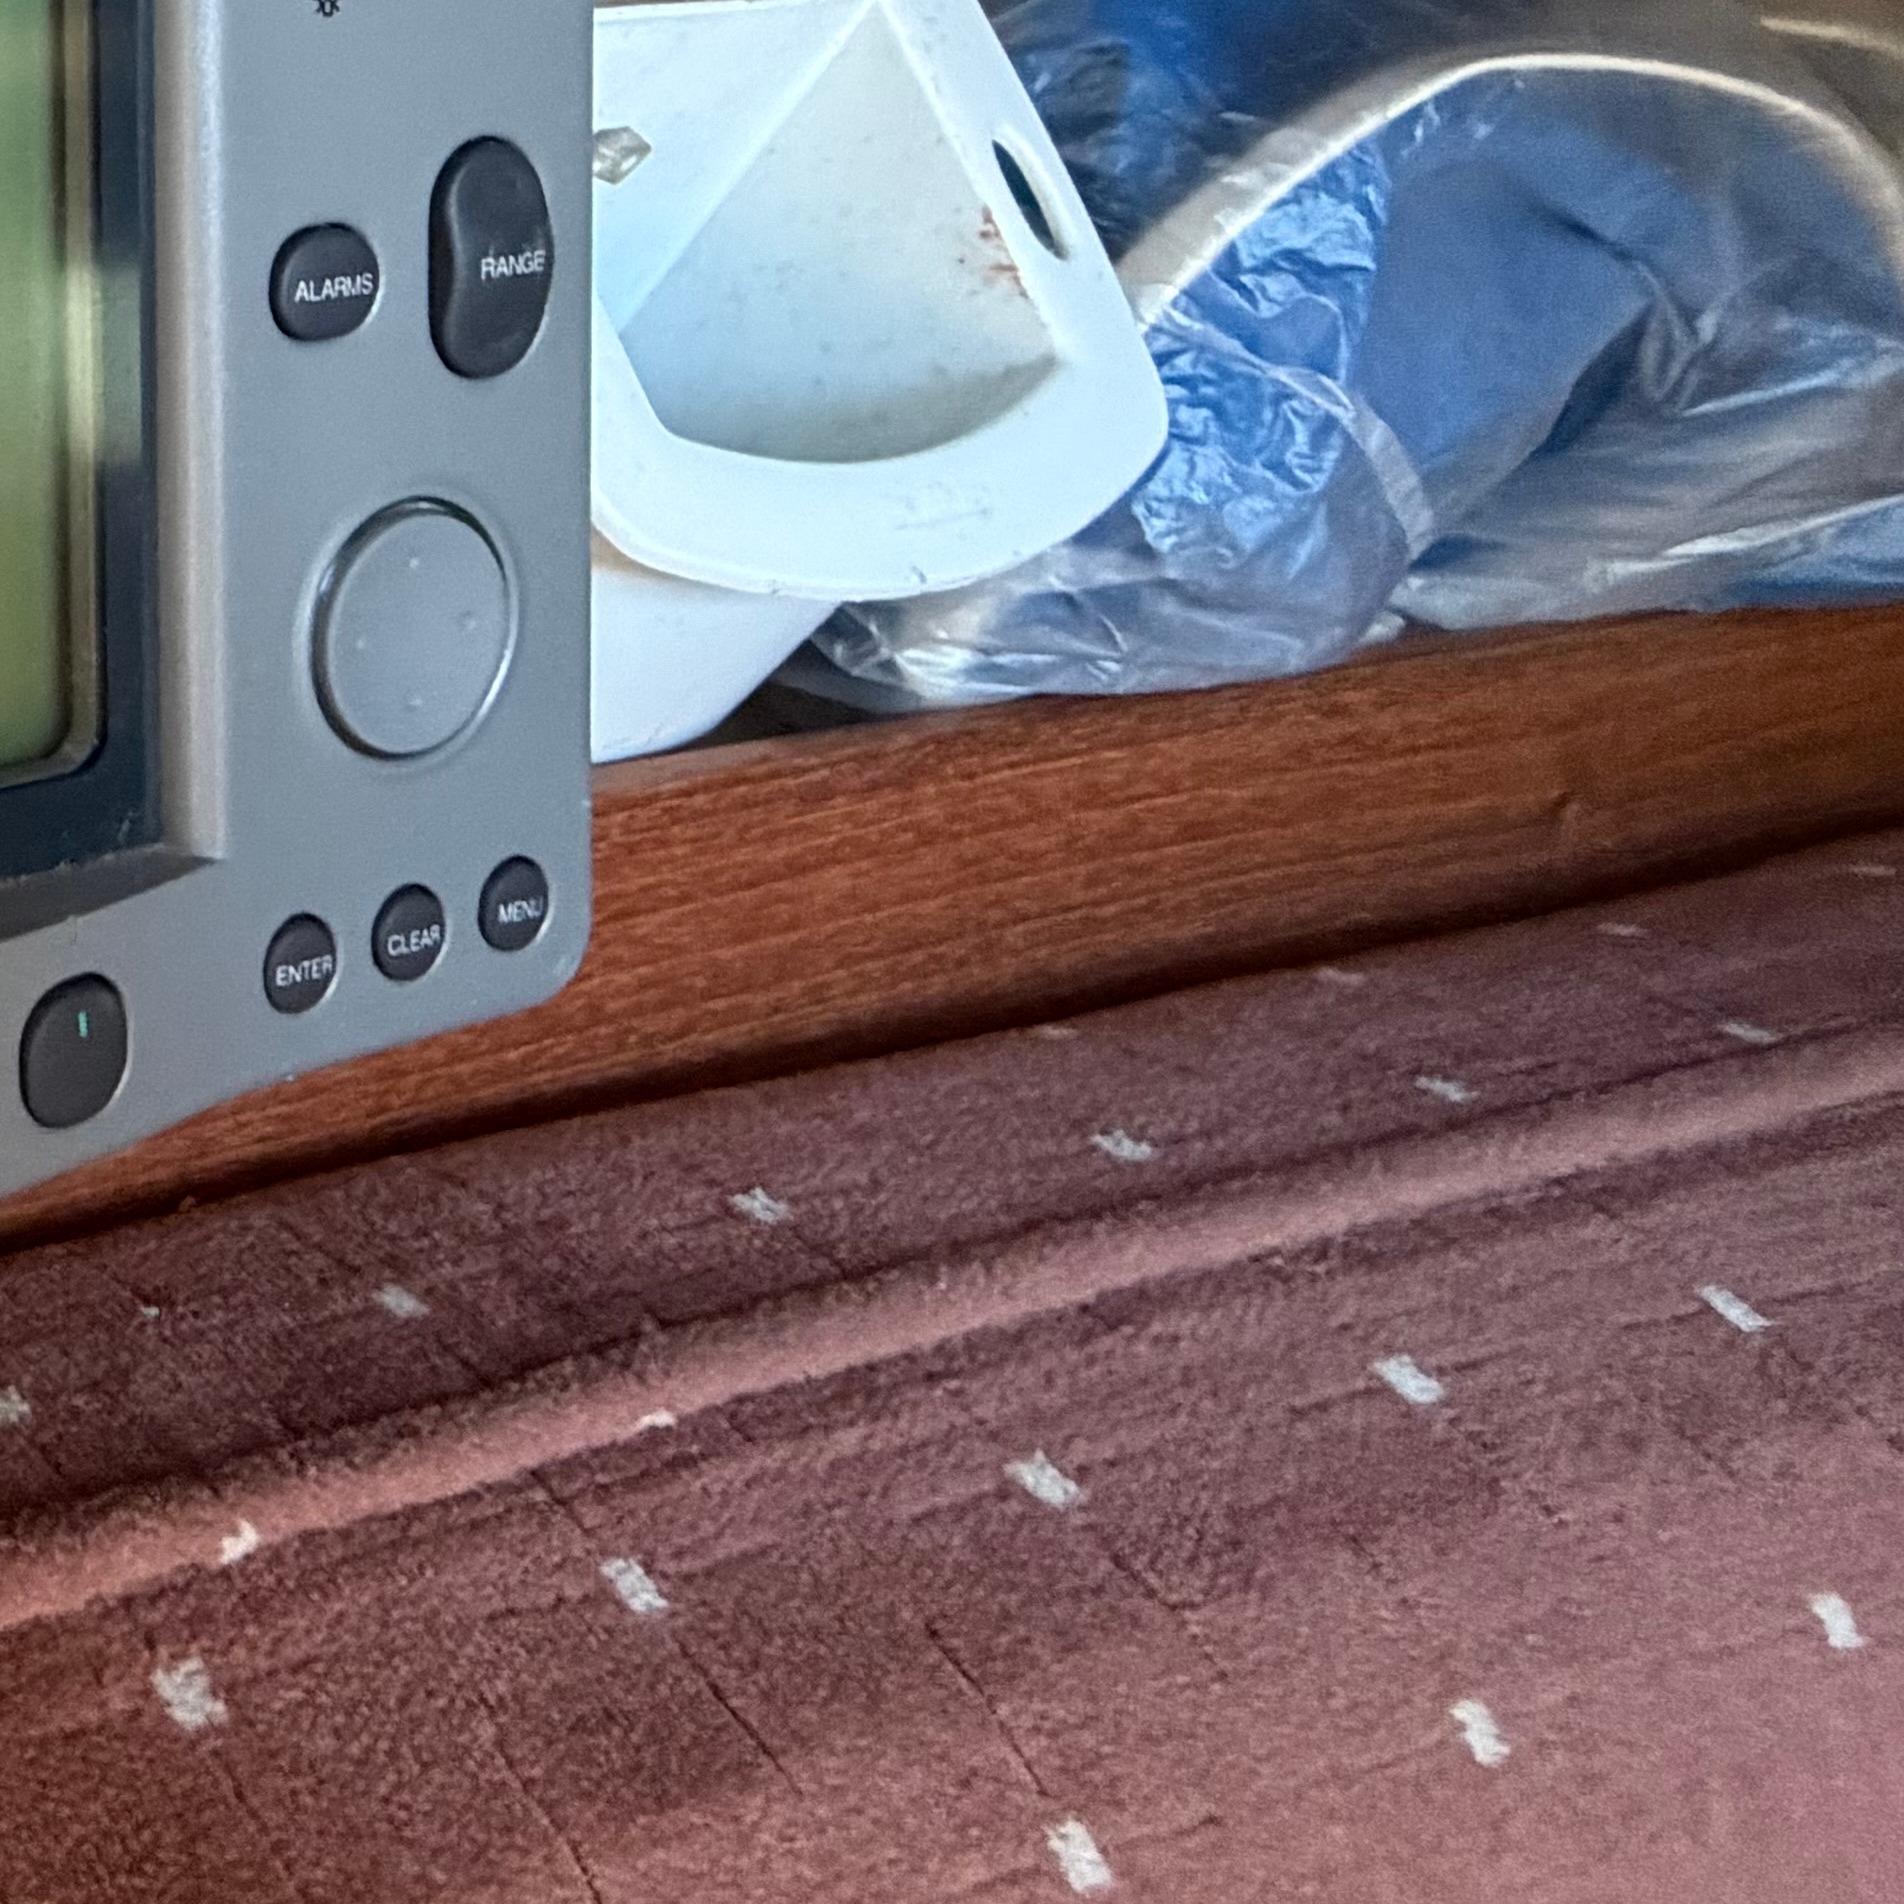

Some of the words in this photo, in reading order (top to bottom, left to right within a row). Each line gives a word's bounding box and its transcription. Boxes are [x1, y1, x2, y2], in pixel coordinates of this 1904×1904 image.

[481, 250, 546, 280] RANGE
[294, 273, 374, 303] ALARMS
[498, 899, 542, 924] MENU
[387, 924, 442, 957] CLEAR
[275, 954, 334, 987] ENTER
